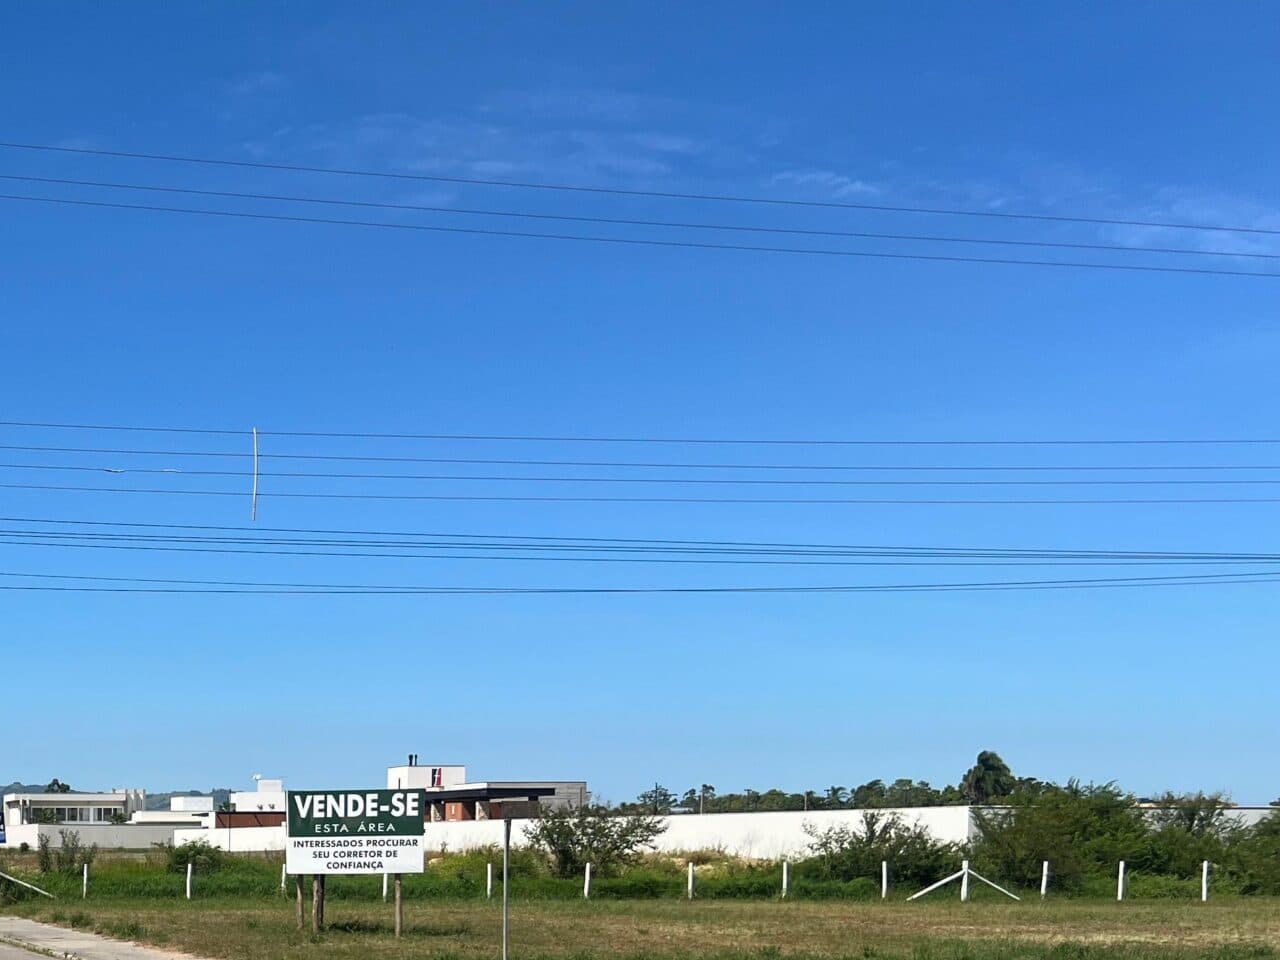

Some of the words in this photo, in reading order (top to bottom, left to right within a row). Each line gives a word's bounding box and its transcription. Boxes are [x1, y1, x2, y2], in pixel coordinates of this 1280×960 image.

[294, 792, 419, 819] VENDE-SE
[315, 823, 349, 833] ESTA
[357, 821, 396, 832] ÁREA
[293, 839, 364, 848] INTERESSADOS
[366, 839, 418, 847] PROCURAR
[312, 851, 330, 859] SEU
[333, 850, 383, 858] CORRETOR
[385, 850, 398, 858] DE
[326, 861, 384, 871] CONFIANÇA
